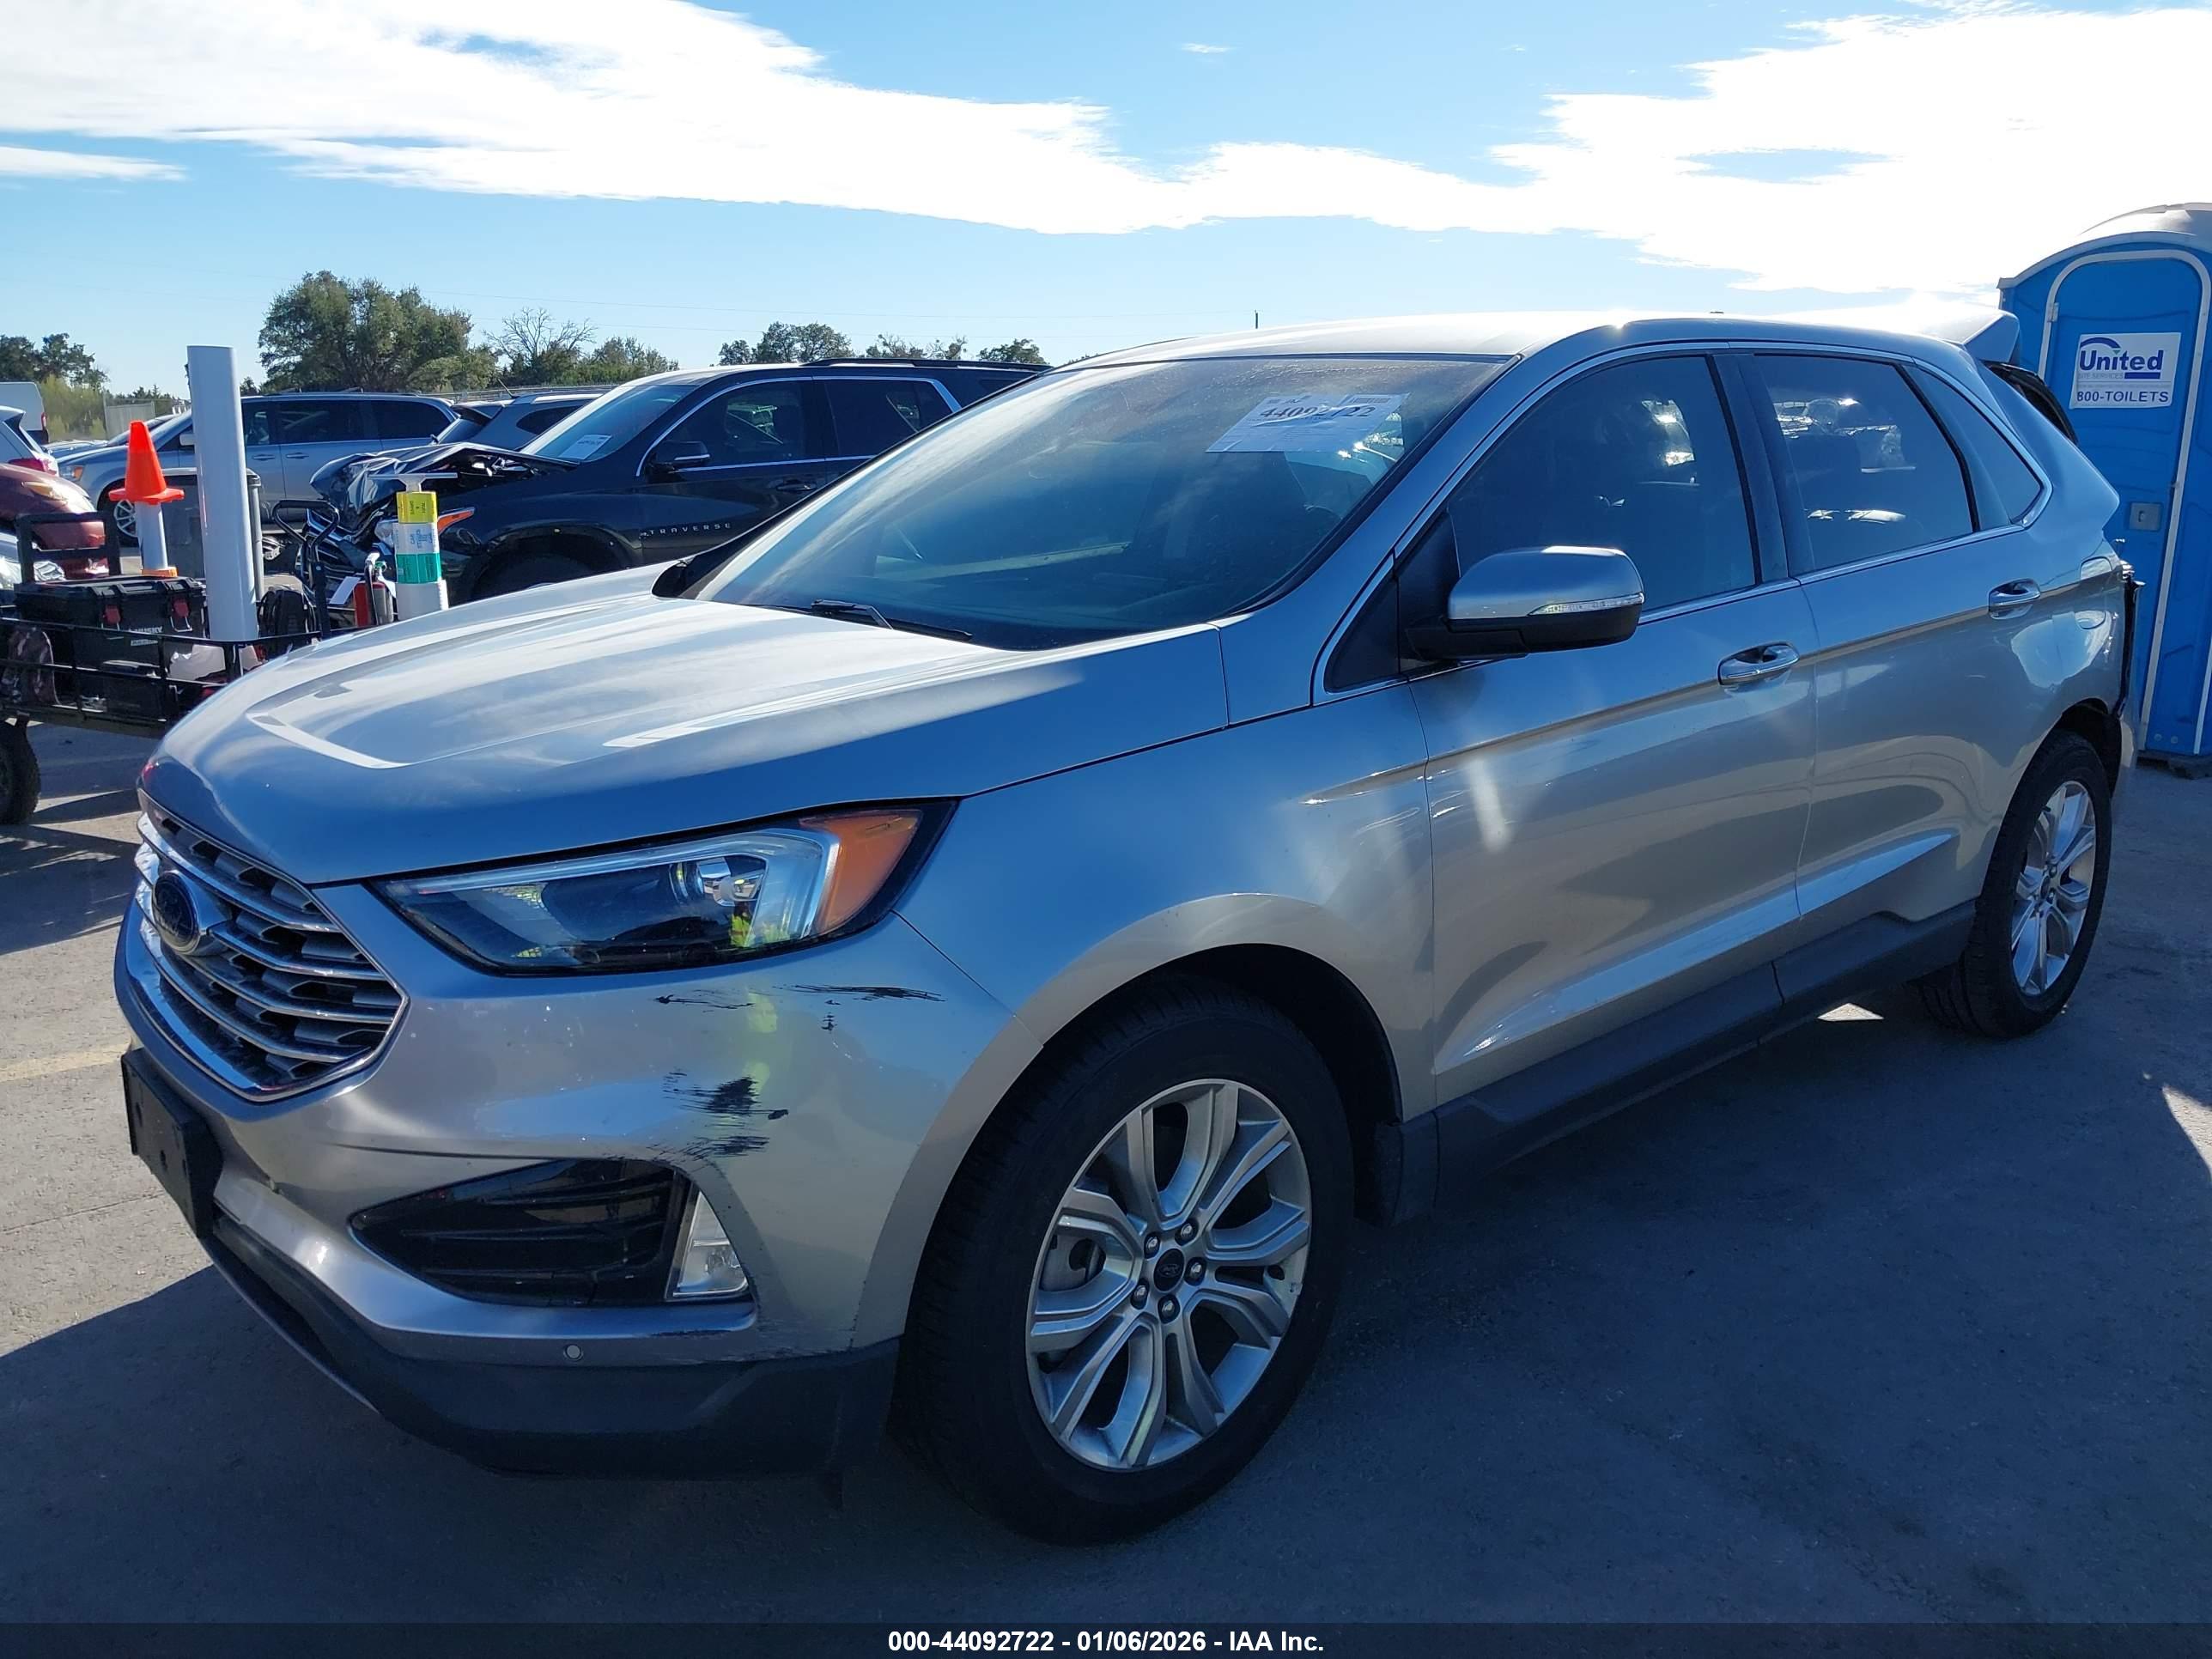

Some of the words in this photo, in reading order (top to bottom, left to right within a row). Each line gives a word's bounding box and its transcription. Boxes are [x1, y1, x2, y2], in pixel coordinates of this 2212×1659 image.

[2080, 350, 2164, 371] United
[2076, 391, 2169, 403] 800-TOILETS
[649, 522, 732, 535] TRAVERSE
